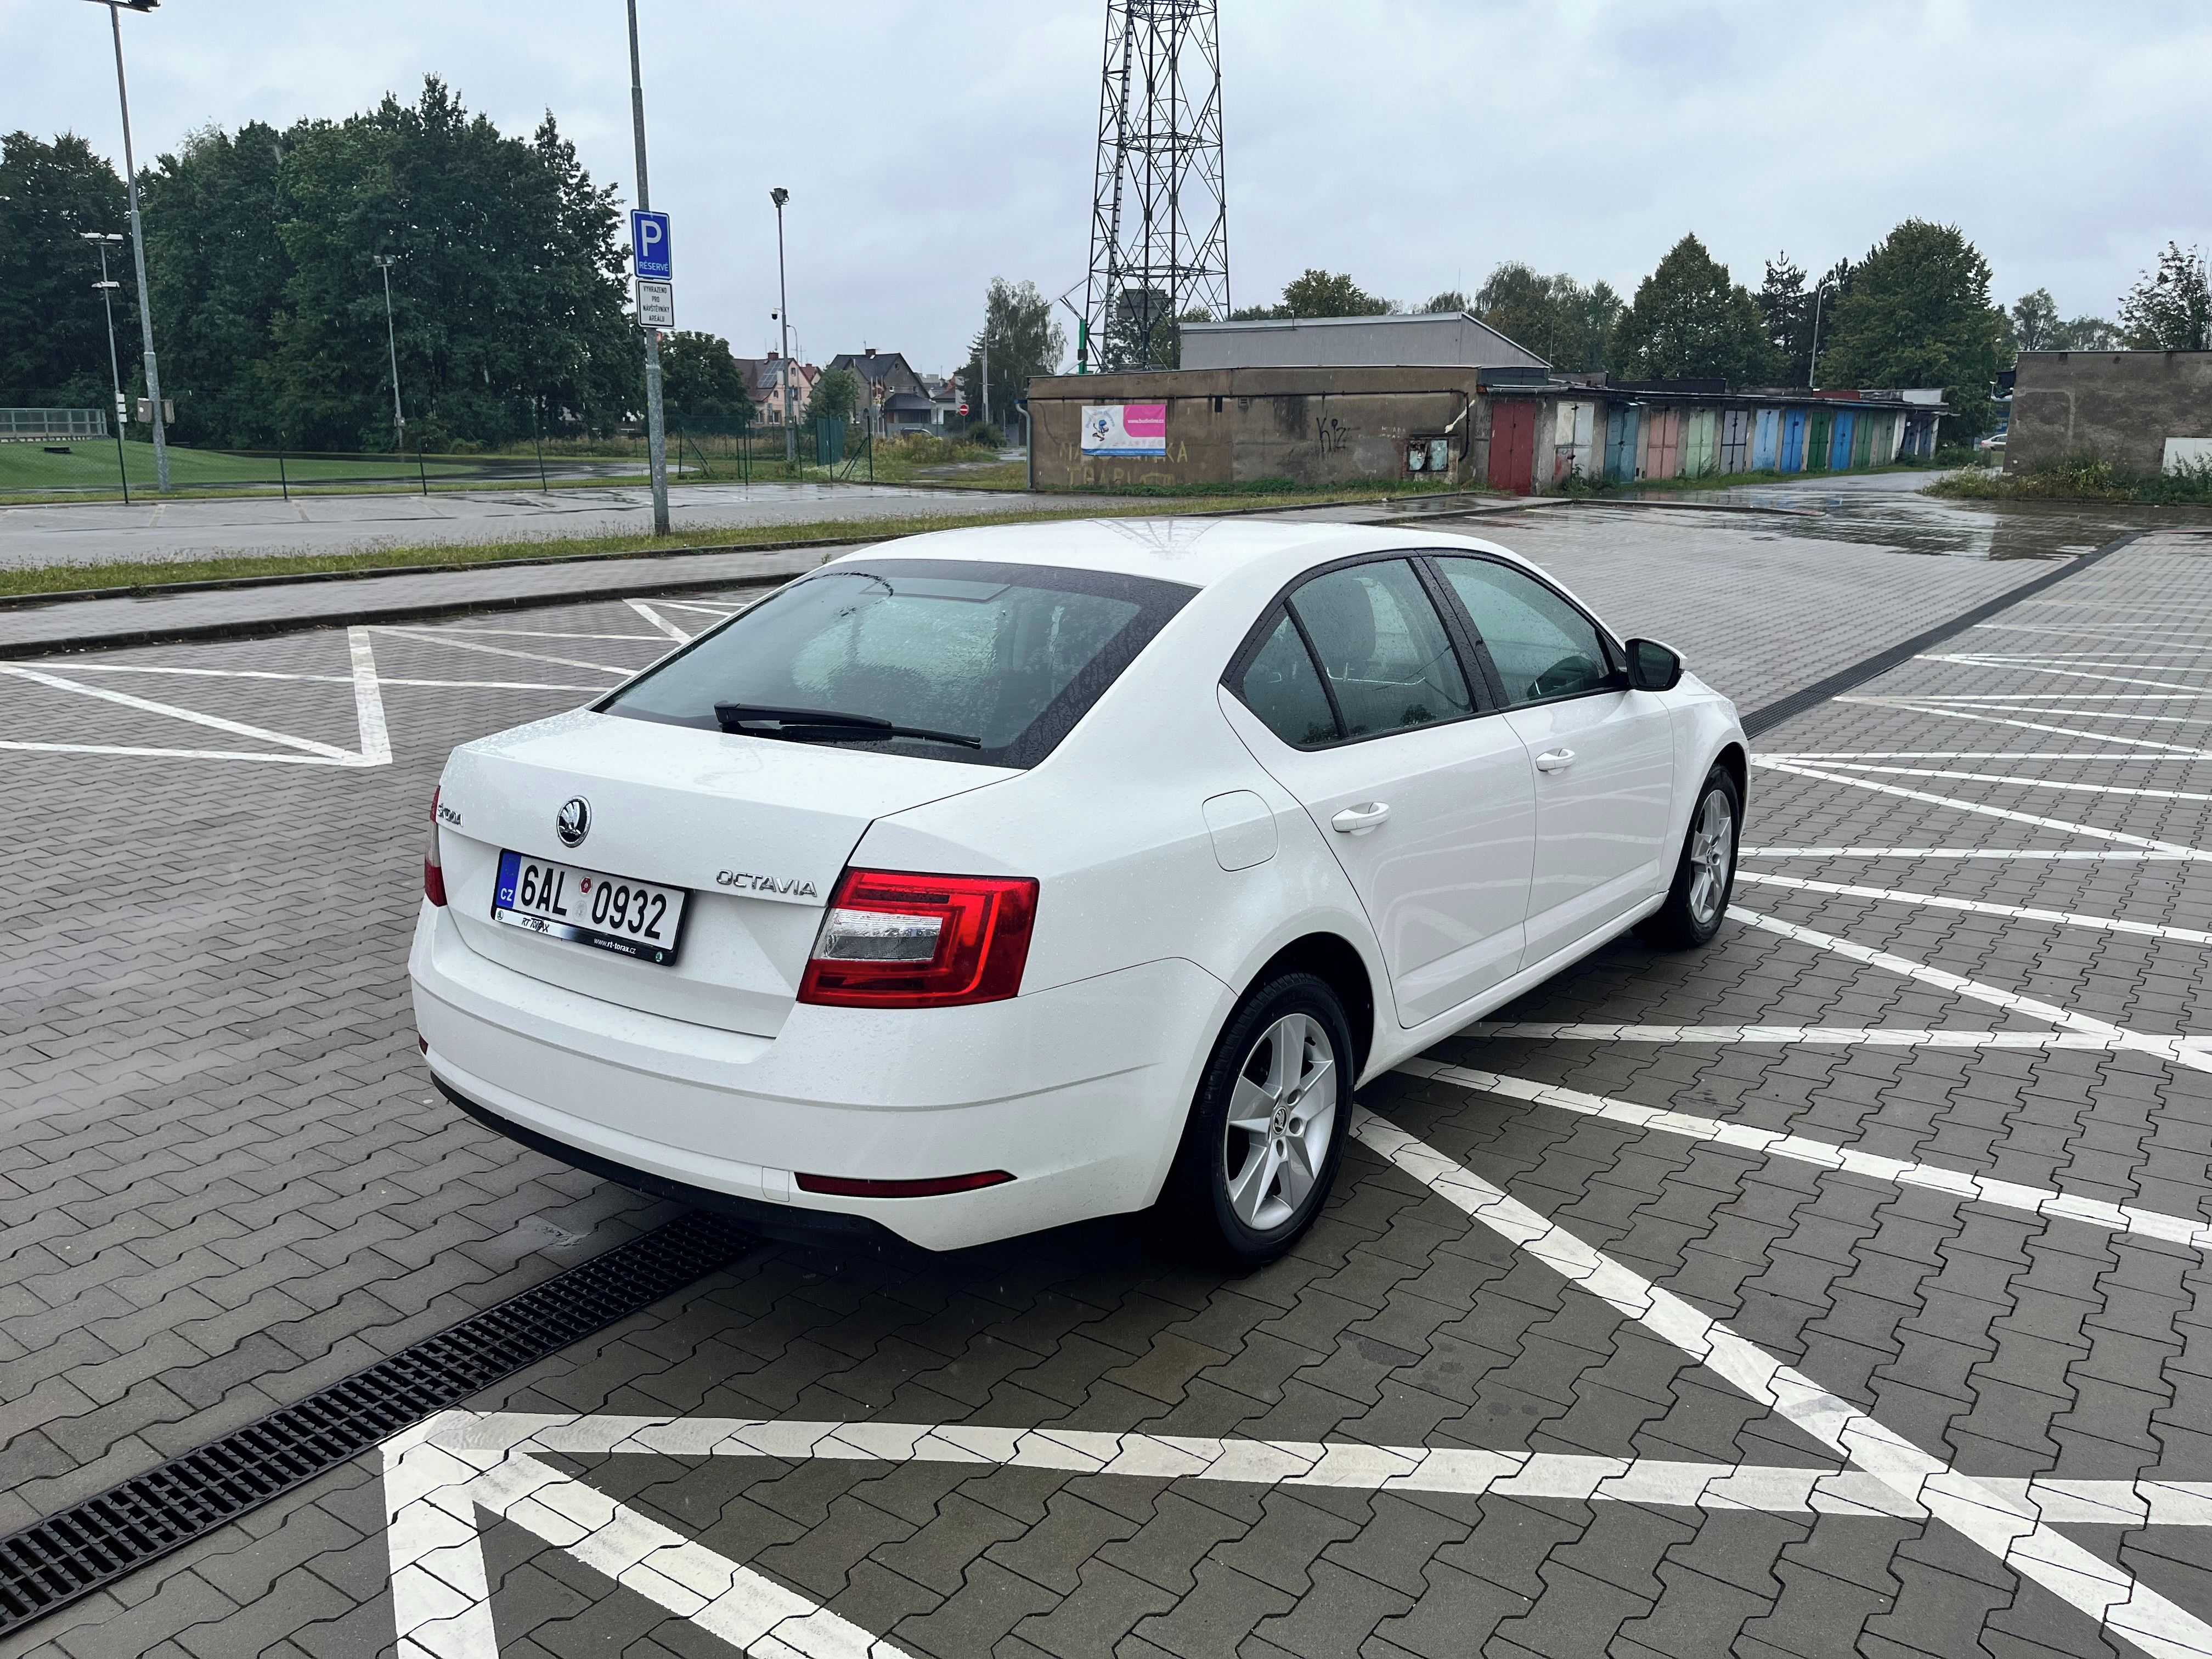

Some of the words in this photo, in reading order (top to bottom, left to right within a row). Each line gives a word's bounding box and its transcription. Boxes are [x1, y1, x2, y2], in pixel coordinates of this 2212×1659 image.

[641, 219, 662, 257] P
[639, 260, 669, 272] RÉSERVÉ
[643, 285, 667, 294] VYHRAZENO
[642, 304, 669, 313] NÁVŠTĚVNÍKY
[648, 314, 665, 322] AREÁLU
[716, 869, 817, 898] OCTAVIA
[500, 888, 514, 902] CZ
[521, 865, 567, 916] 6AL
[592, 881, 667, 940] 0932
[594, 938, 636, 955] www.rt-torax.cz
